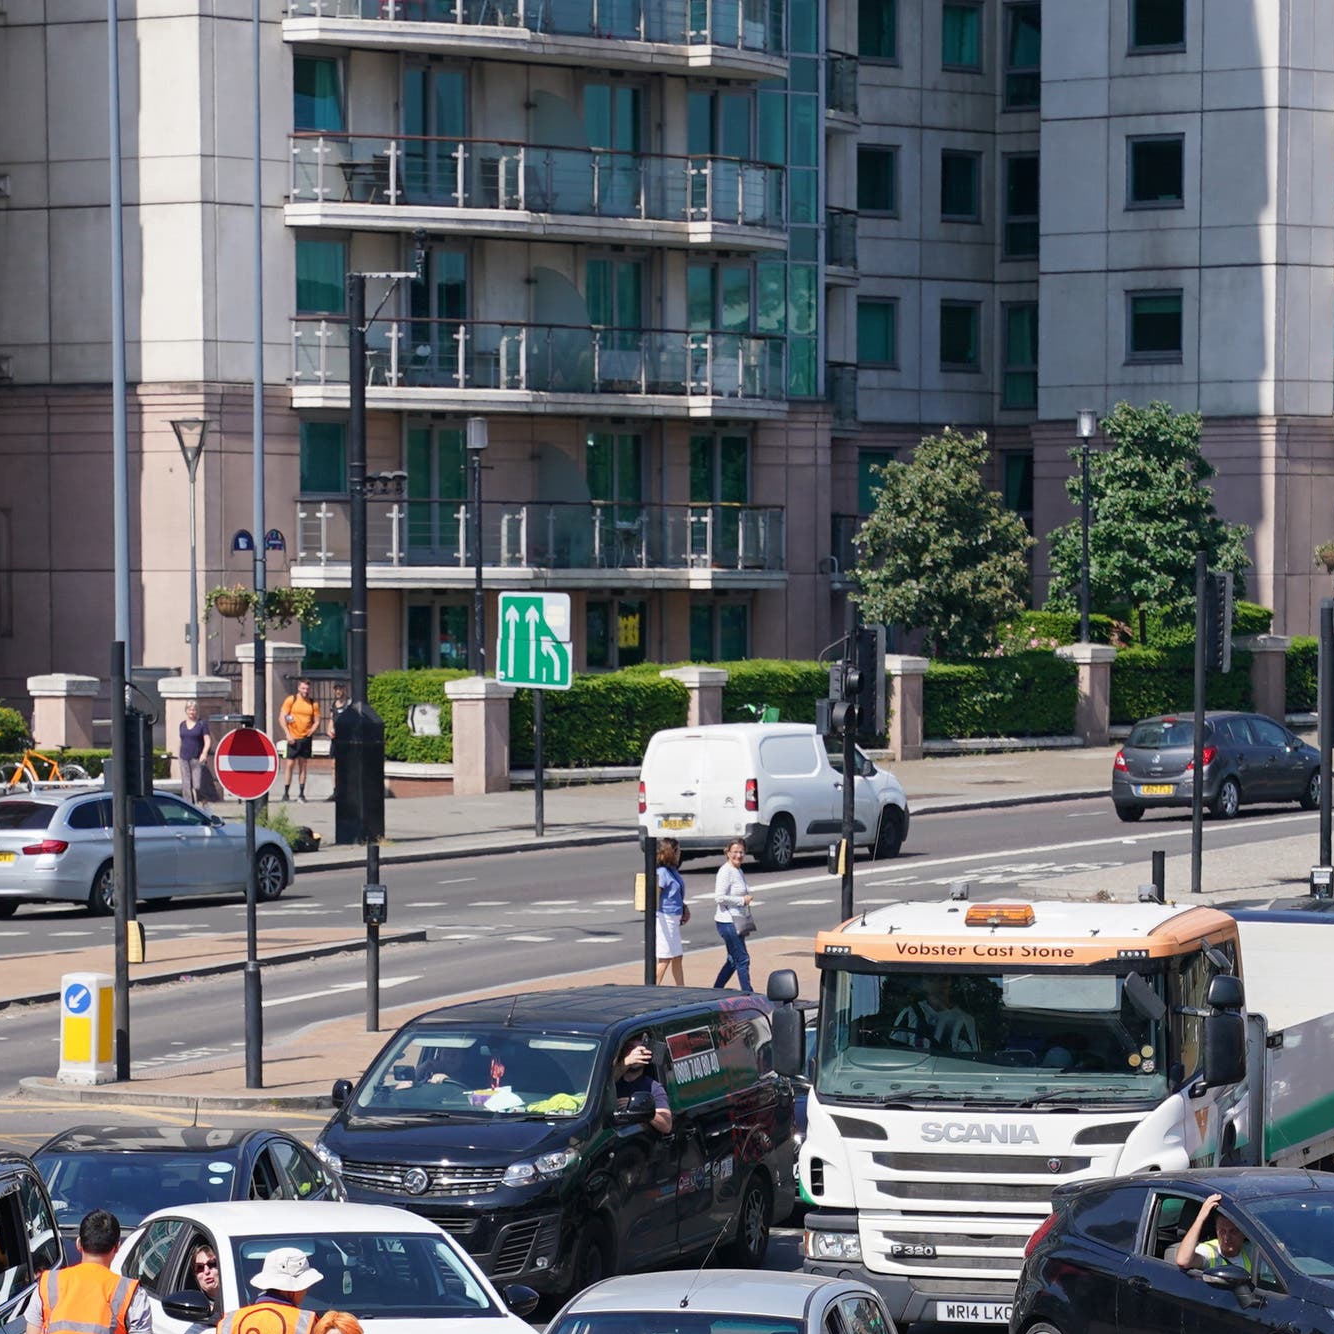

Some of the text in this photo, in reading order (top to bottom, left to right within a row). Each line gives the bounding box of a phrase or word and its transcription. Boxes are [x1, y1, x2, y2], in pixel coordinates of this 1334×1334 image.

[895, 941, 1075, 958] Vobster Cast Stone
[920, 1121, 1040, 1145] SCANIA
[892, 1245, 934, 1257] P 320
[946, 1305, 979, 1319] WR14
